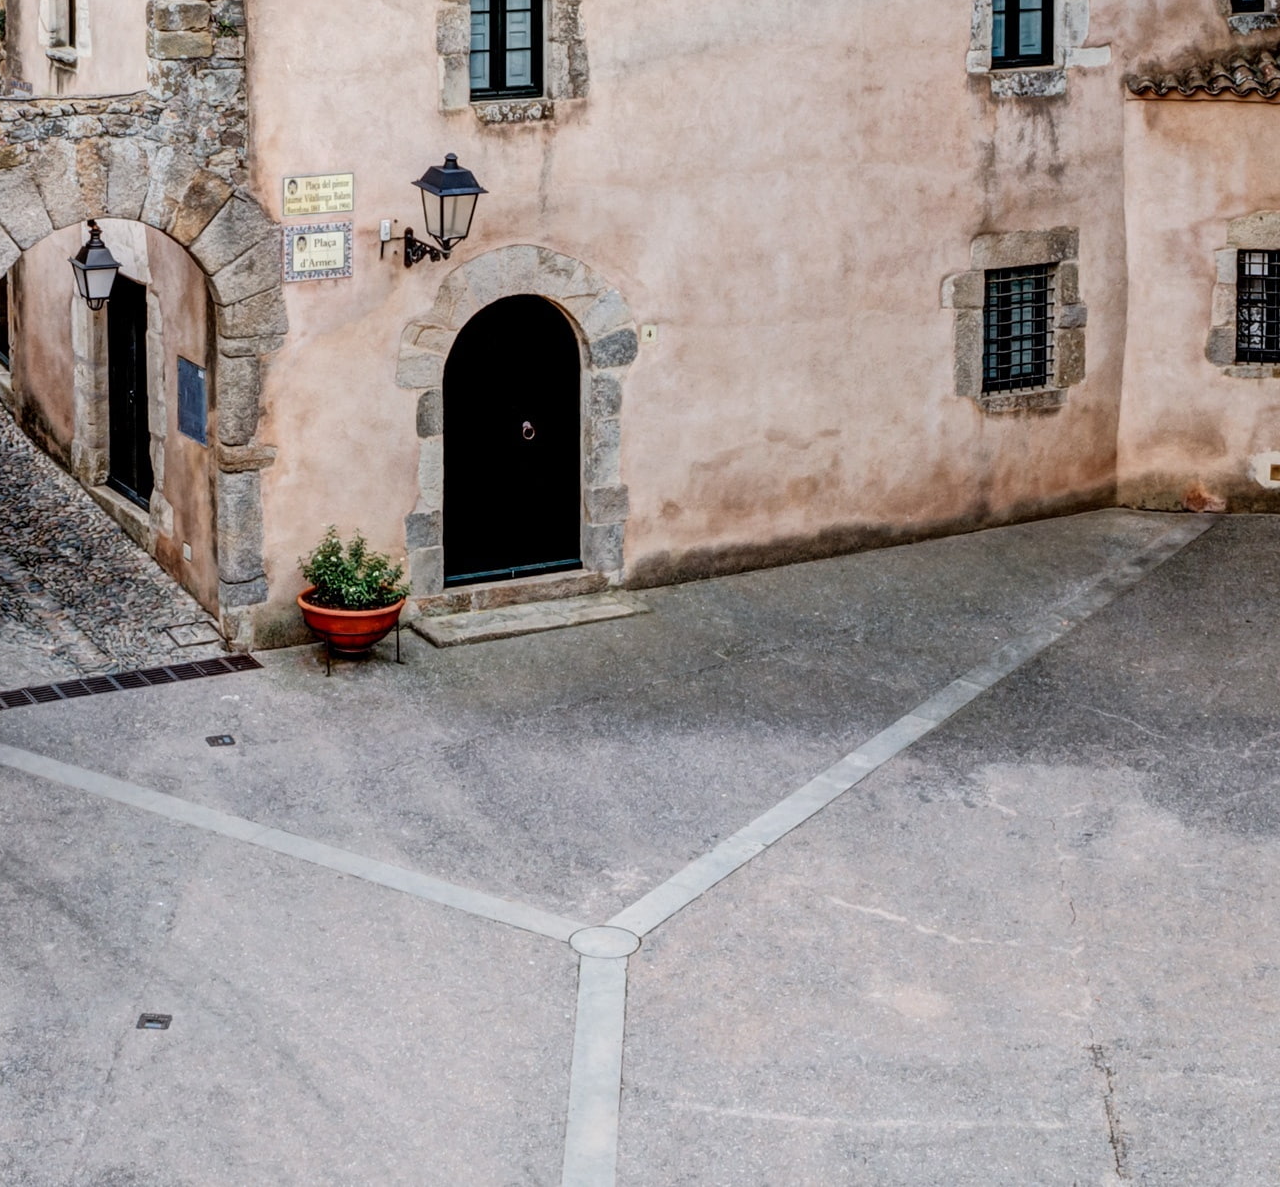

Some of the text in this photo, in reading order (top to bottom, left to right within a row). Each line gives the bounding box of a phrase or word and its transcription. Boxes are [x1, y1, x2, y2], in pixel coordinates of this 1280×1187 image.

[305, 181, 320, 191] Plaça
[322, 179, 331, 189] del
[314, 238, 336, 248] Plaça
[300, 258, 337, 268] d'Armes
